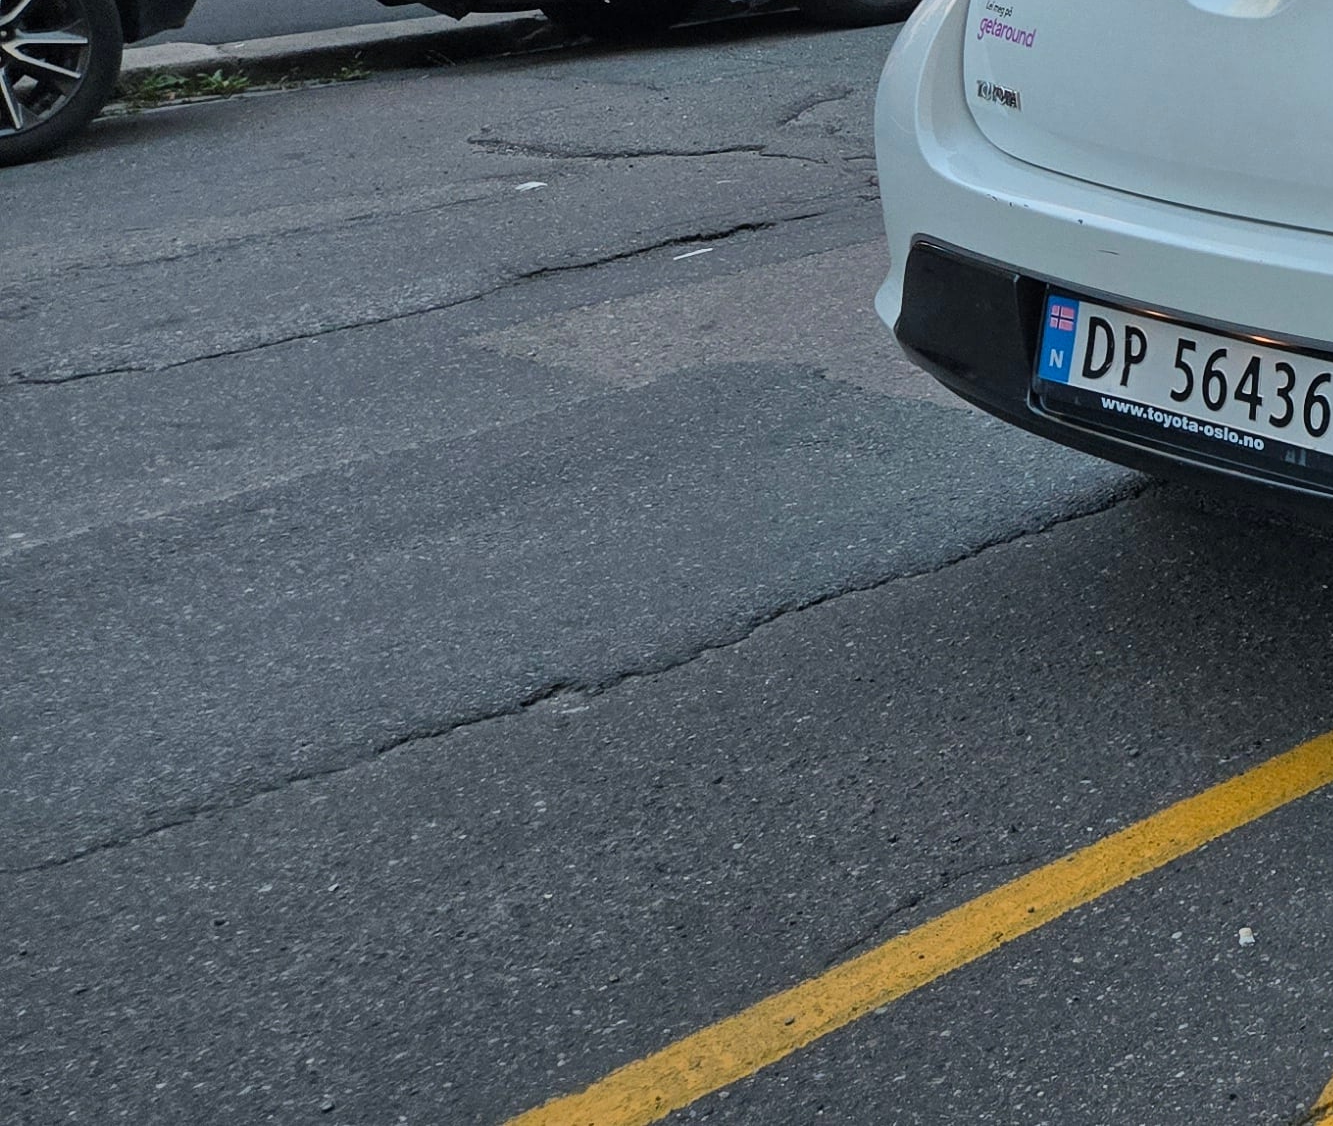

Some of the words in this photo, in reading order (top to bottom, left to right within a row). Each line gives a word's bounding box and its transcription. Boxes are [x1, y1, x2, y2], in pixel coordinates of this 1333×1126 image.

[978, 18, 1036, 48] getaround
[1049, 348, 1064, 369] N
[1082, 316, 1148, 387] DP
[1170, 337, 1332, 438] 56436
[1101, 396, 1265, 451] www.toyota-oslo.no
